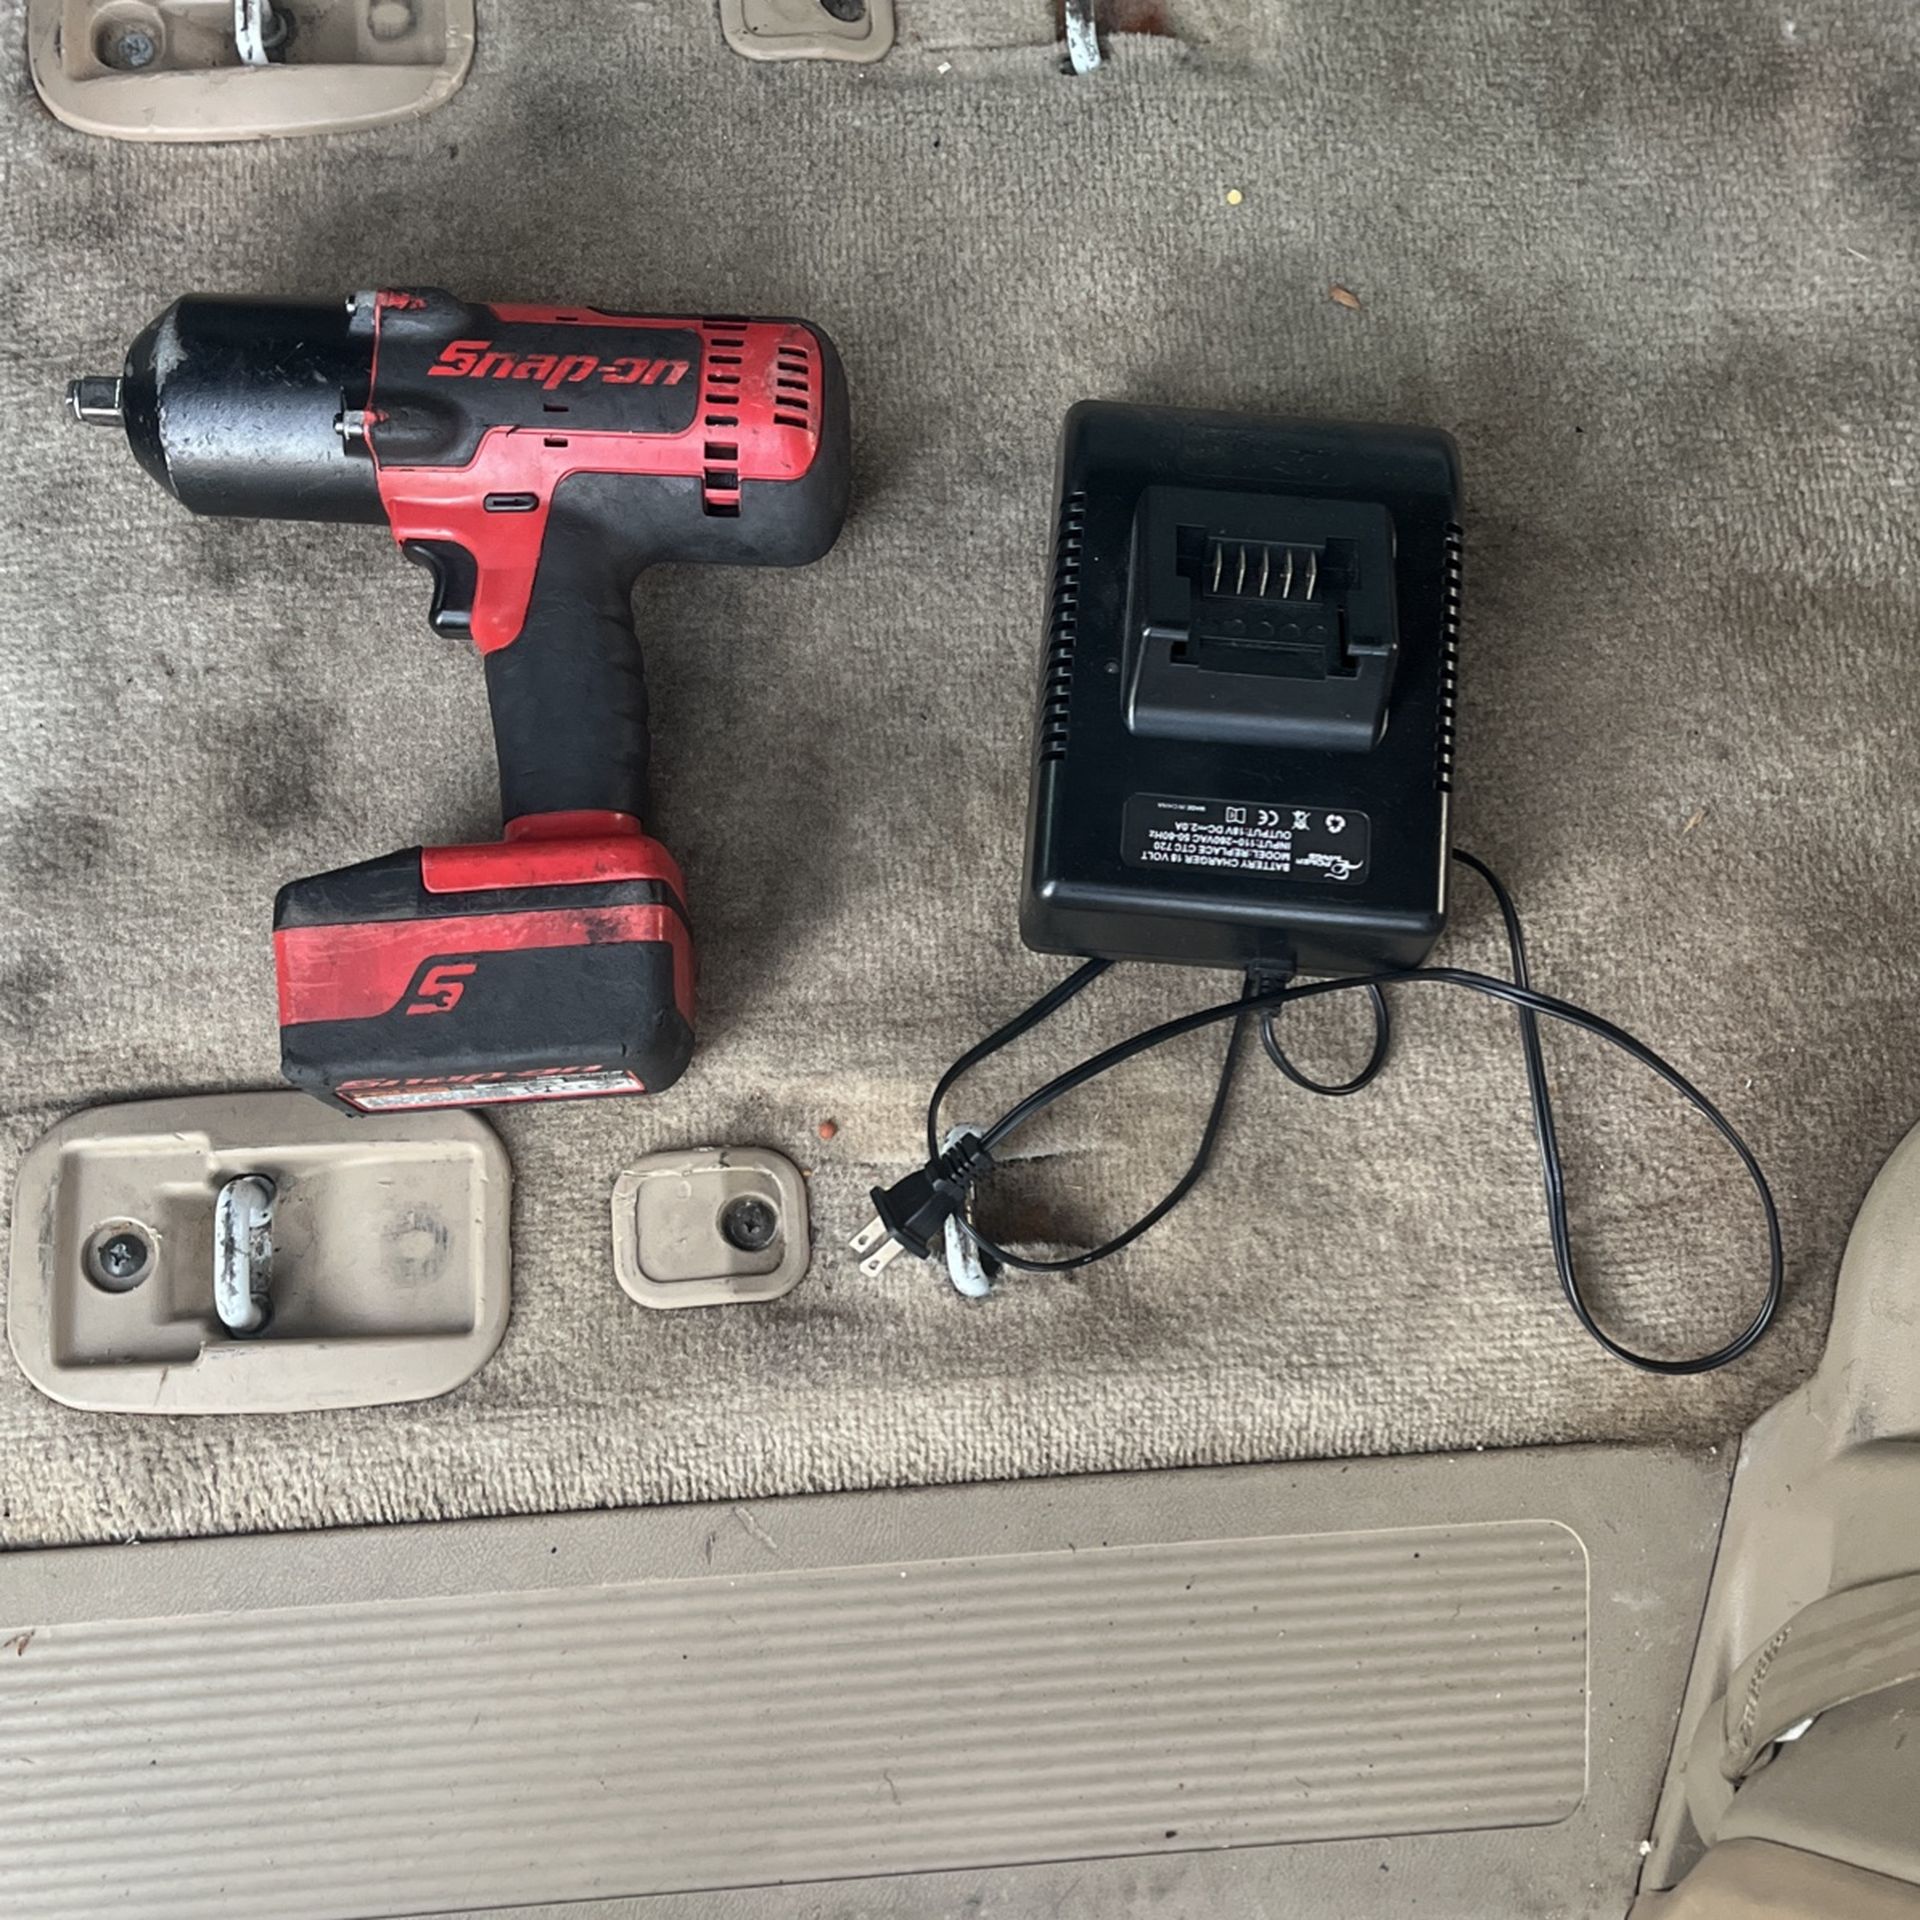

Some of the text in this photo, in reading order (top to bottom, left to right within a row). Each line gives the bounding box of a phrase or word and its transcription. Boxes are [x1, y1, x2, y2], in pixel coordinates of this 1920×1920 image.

[427, 340, 690, 390] Snap-on
[1148, 829, 1191, 841] 50-60Hz
[1225, 827, 1292, 840] OUTPUT:18V
[1153, 841, 1291, 861] MODEL:REPLACE CTC 720
[1140, 851, 1290, 872] BATTERY CHARGER 18 VOLT
